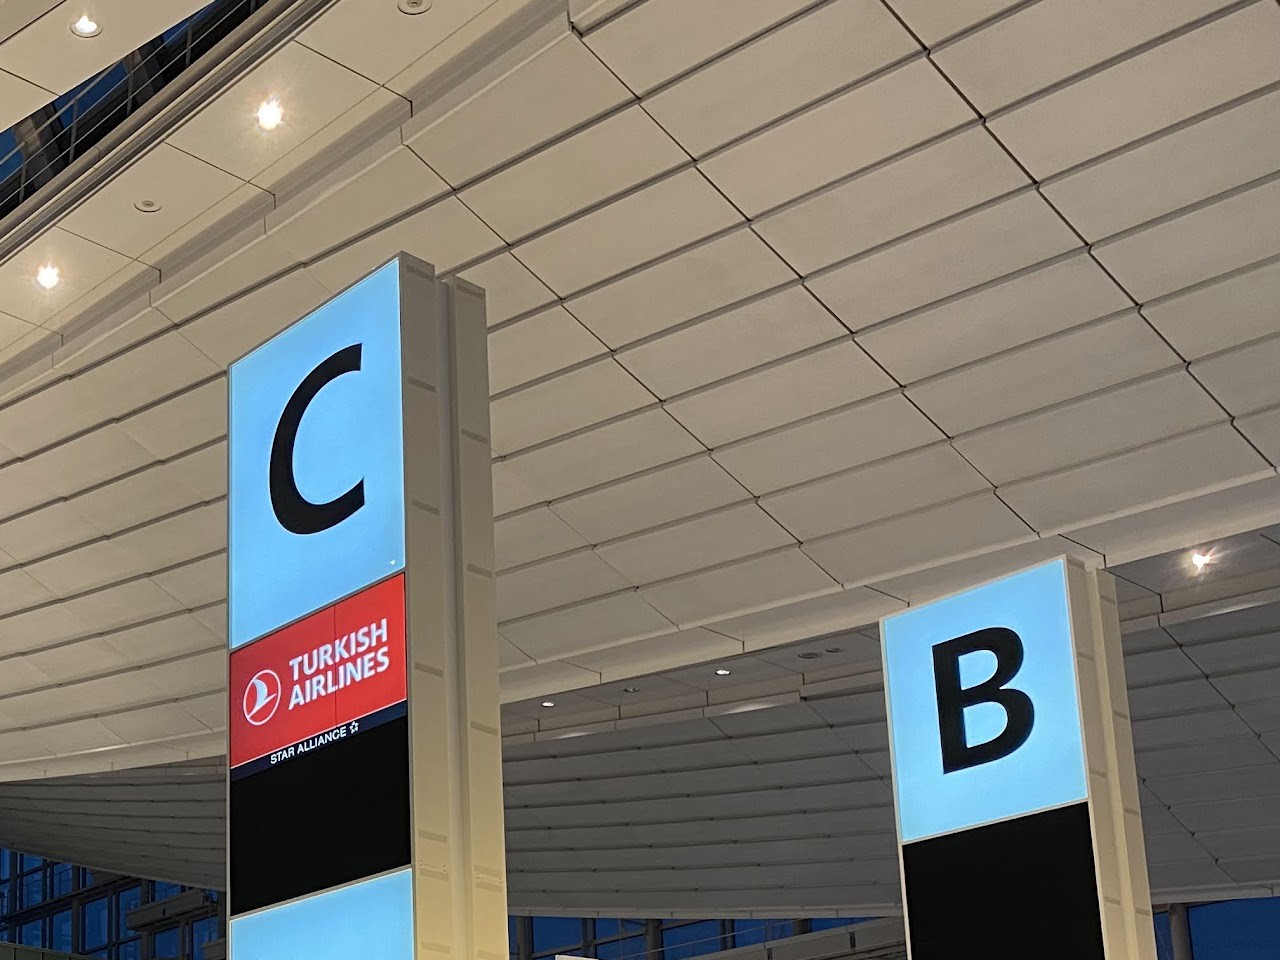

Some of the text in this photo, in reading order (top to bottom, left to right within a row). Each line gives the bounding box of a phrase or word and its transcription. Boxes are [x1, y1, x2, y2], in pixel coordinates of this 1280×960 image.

[269, 343, 365, 535] C
[288, 646, 390, 710] AIRLINES
[289, 618, 388, 681] TURKISH
[932, 627, 1035, 775] B
[270, 726, 346, 765] STAR ALLIANCE
